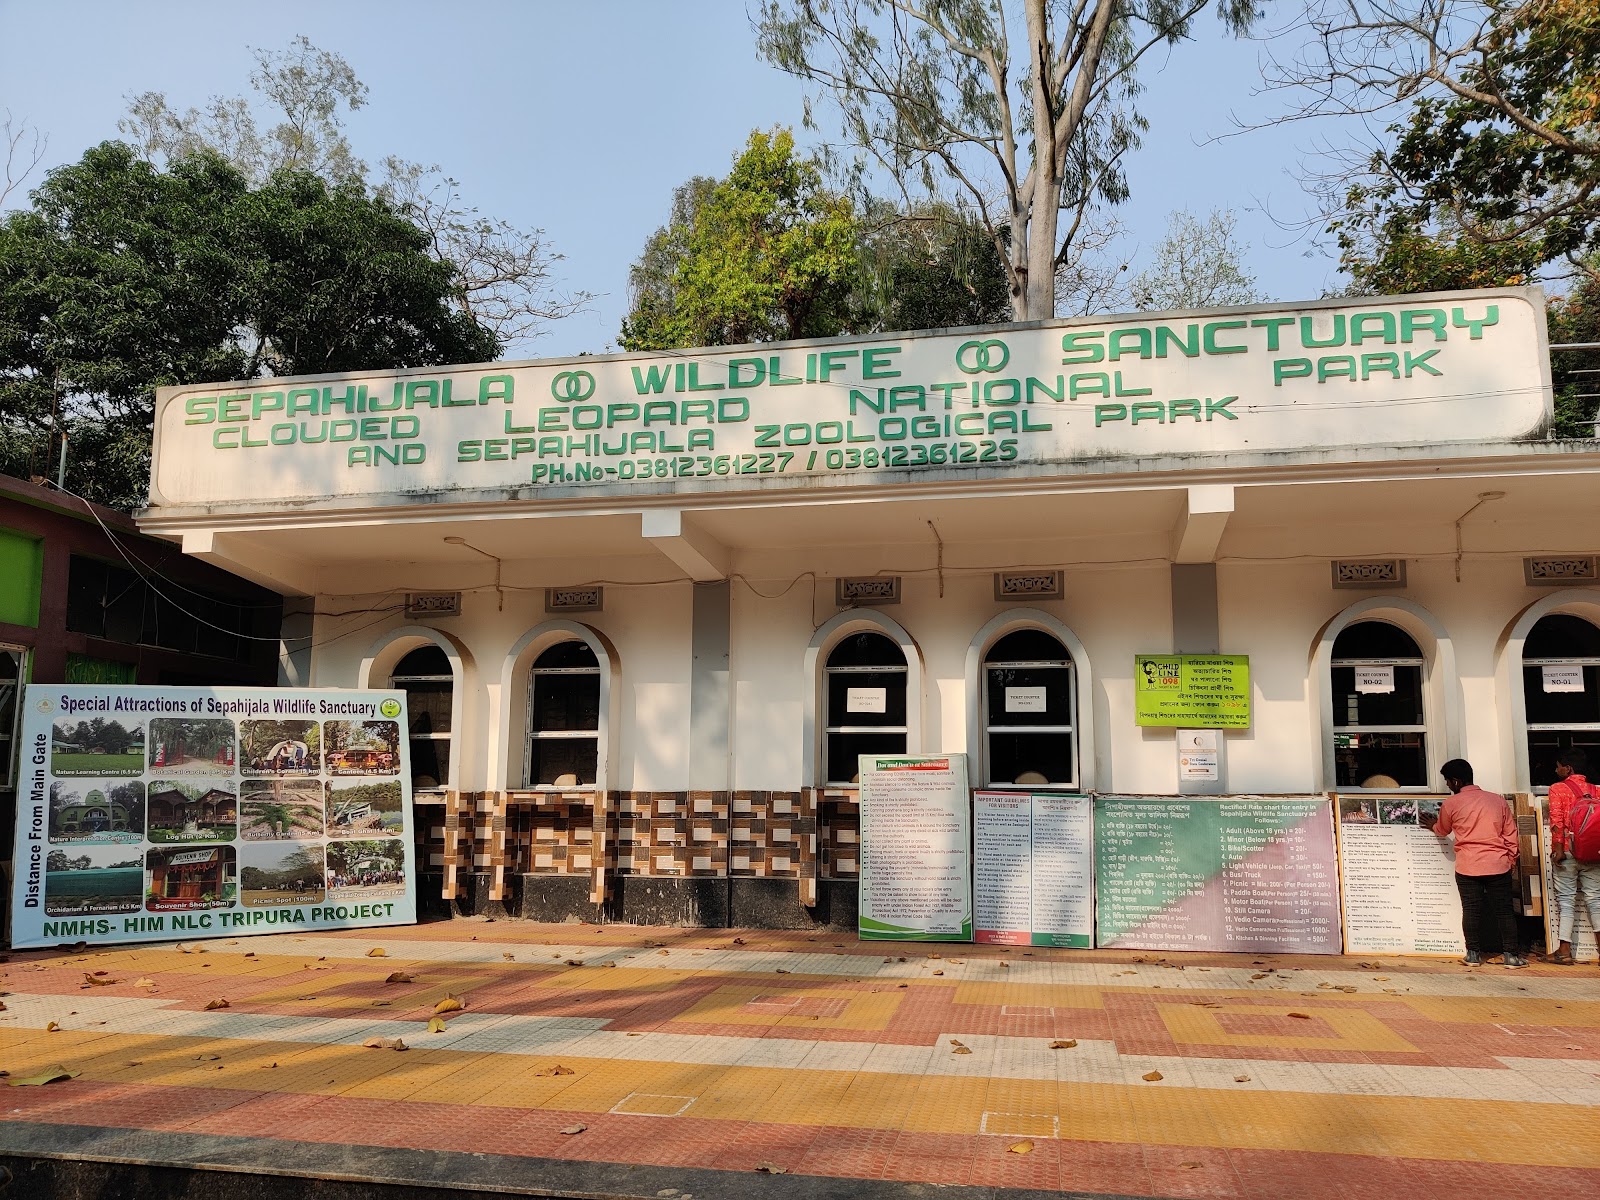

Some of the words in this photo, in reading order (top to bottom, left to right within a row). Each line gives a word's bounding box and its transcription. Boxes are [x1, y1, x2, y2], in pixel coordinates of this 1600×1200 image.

[185, 374, 515, 426] SEPAHIJALA
[631, 346, 902, 394] WILDLIFE
[1062, 305, 1499, 365] SANCTUARY
[213, 415, 420, 449] CLOUDED
[505, 397, 750, 434] LEOPARD
[850, 371, 1152, 416] NATIONAL
[1274, 349, 1443, 386] PARK
[348, 444, 426, 467] AND
[458, 428, 714, 462] SEPAHIJALA
[755, 409, 1052, 447] ZOOLOGICAL
[1095, 396, 1239, 427] PARK
[826, 439, 1019, 470] 03812361225
[1158, 677, 1179, 685] 1098
[61, 694, 109, 714] Special
[115, 696, 187, 713] Attractions
[191, 697, 203, 713] of
[207, 697, 269, 717] Sepahijala
[273, 698, 315, 714] Wildlife
[320, 699, 376, 718] Sanctuary
[32, 733, 47, 764] Gate
[31, 769, 45, 801] Main
[29, 805, 43, 840] From
[1243, 827, 1265, 835] (Above
[198, 850, 211, 858] SHOP
[1245, 836, 1266, 844] (Below
[25, 845, 42, 908] Distance
[1228, 862, 1244, 870] Light
[43, 919, 117, 938] NMHS-
[123, 917, 164, 933] HIM
[172, 914, 212, 930] NLC
[219, 909, 305, 928] TRIPURA
[311, 903, 394, 921] PROJECT
